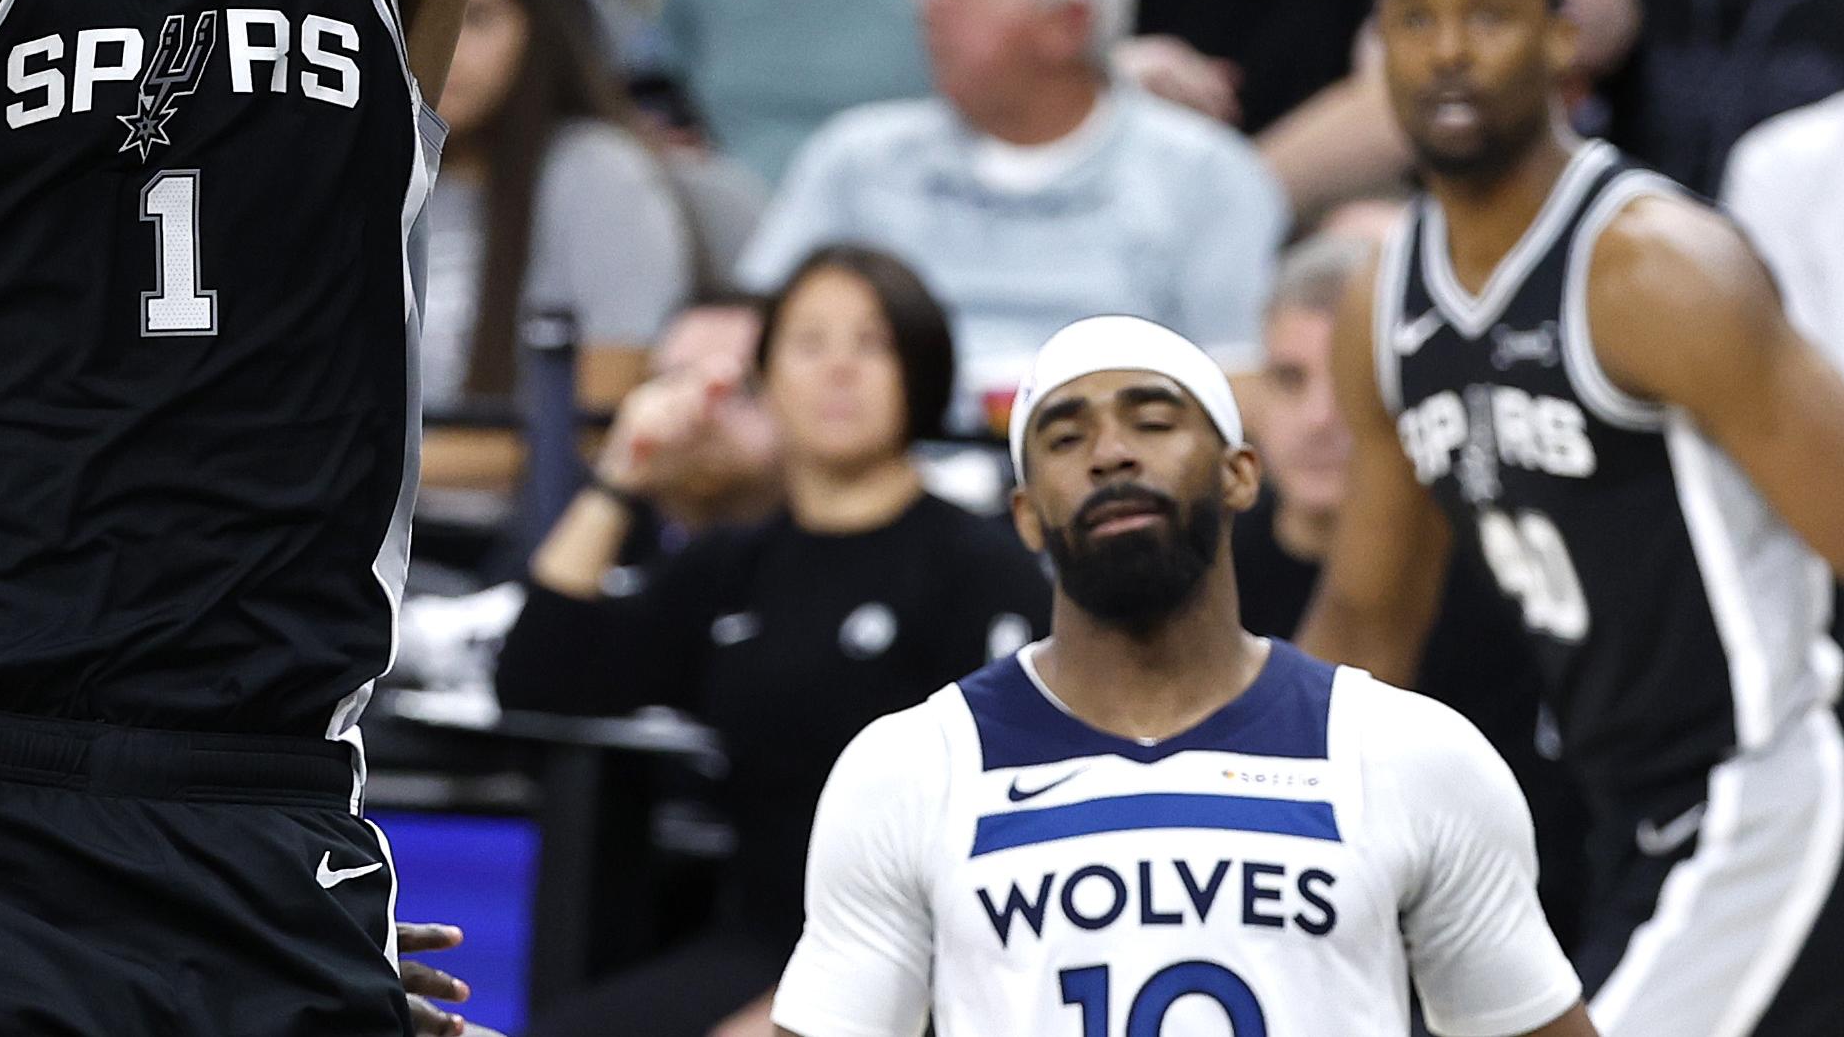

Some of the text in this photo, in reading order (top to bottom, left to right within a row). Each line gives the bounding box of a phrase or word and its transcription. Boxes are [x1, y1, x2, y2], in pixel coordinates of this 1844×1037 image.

[6, 9, 360, 162] SPURS
[139, 169, 218, 337] 1
[976, 859, 1337, 949] WOLVES
